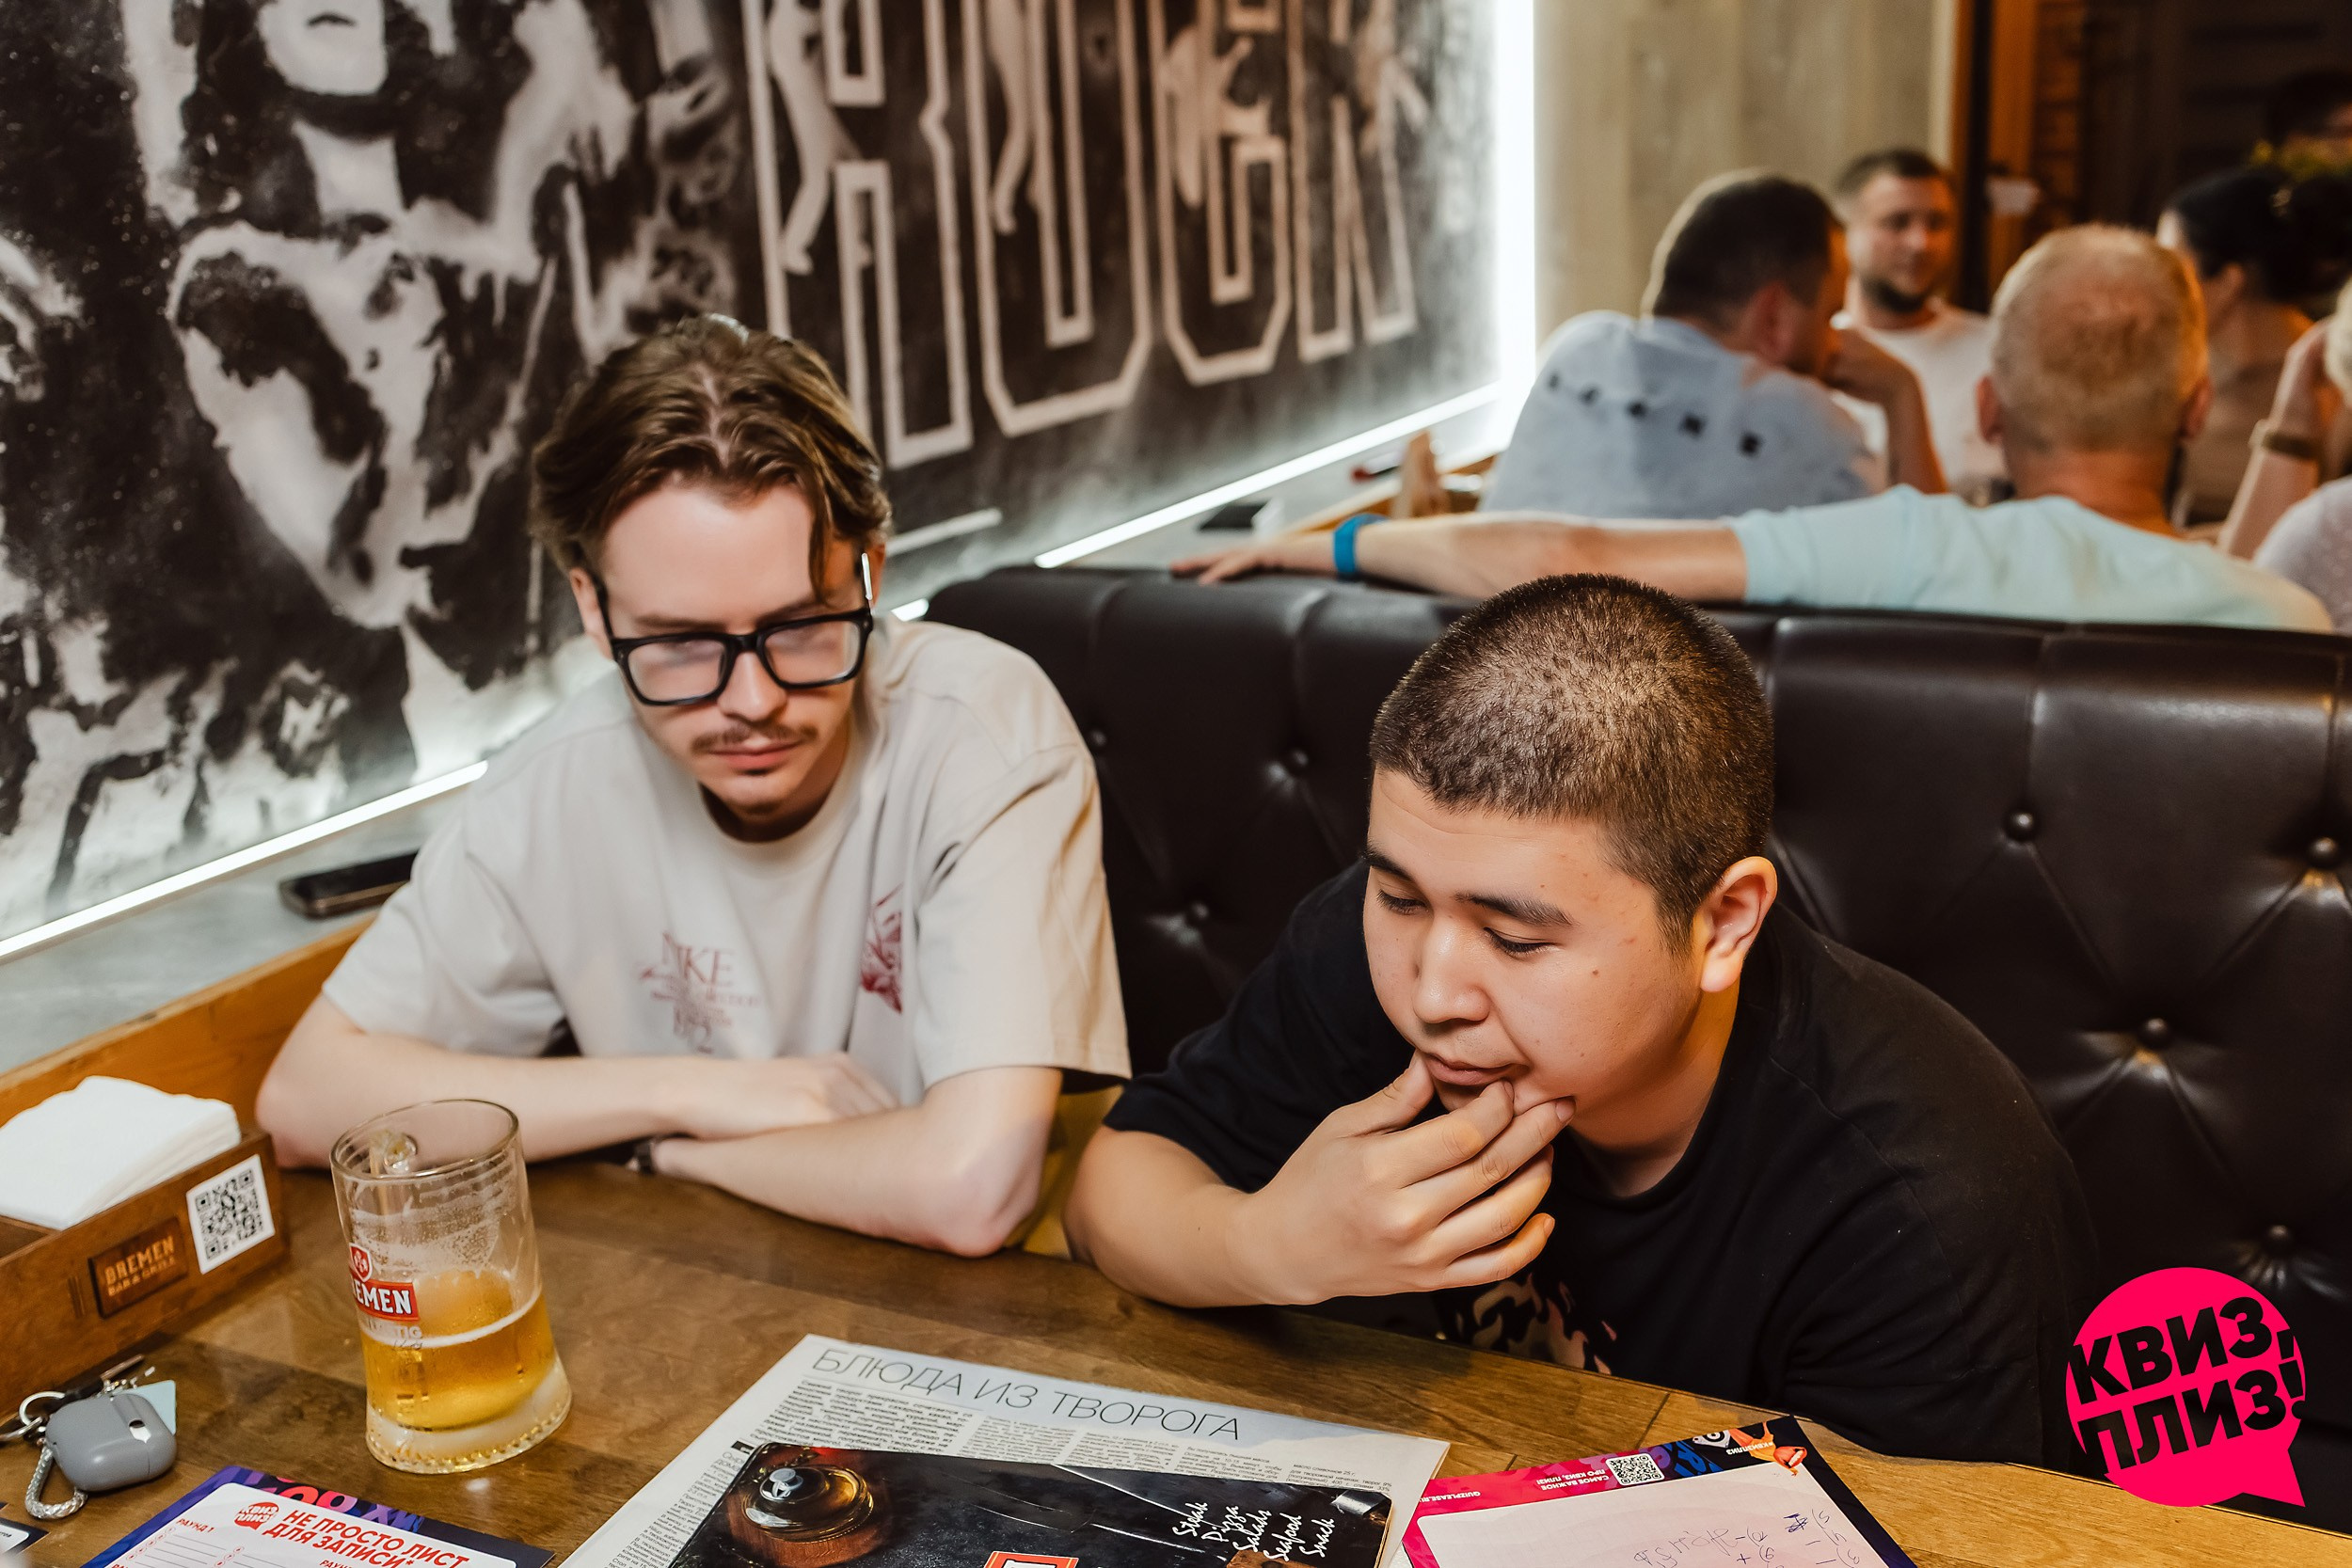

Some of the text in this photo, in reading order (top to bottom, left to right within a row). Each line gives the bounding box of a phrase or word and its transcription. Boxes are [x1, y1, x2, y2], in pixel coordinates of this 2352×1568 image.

[353, 1279, 412, 1314] EMEN
[812, 1349, 963, 1400] БЛЮДА
[975, 1379, 1038, 1409] ИЗ
[1052, 1390, 1240, 1440] ТВОРОГА
[1541, 1475, 1610, 1491] САМОЕ ВАЖНОЕ
[176, 1518, 209, 1532] РАУНД
[262, 1523, 318, 1544] ДЛЯ
[1172, 1502, 1209, 1537] Steak
[1200, 1505, 1248, 1543] Pizza
[1263, 1513, 1306, 1561] Seafood
[282, 1510, 470, 1568] НЕ ПРОСТО ЛИСТ
